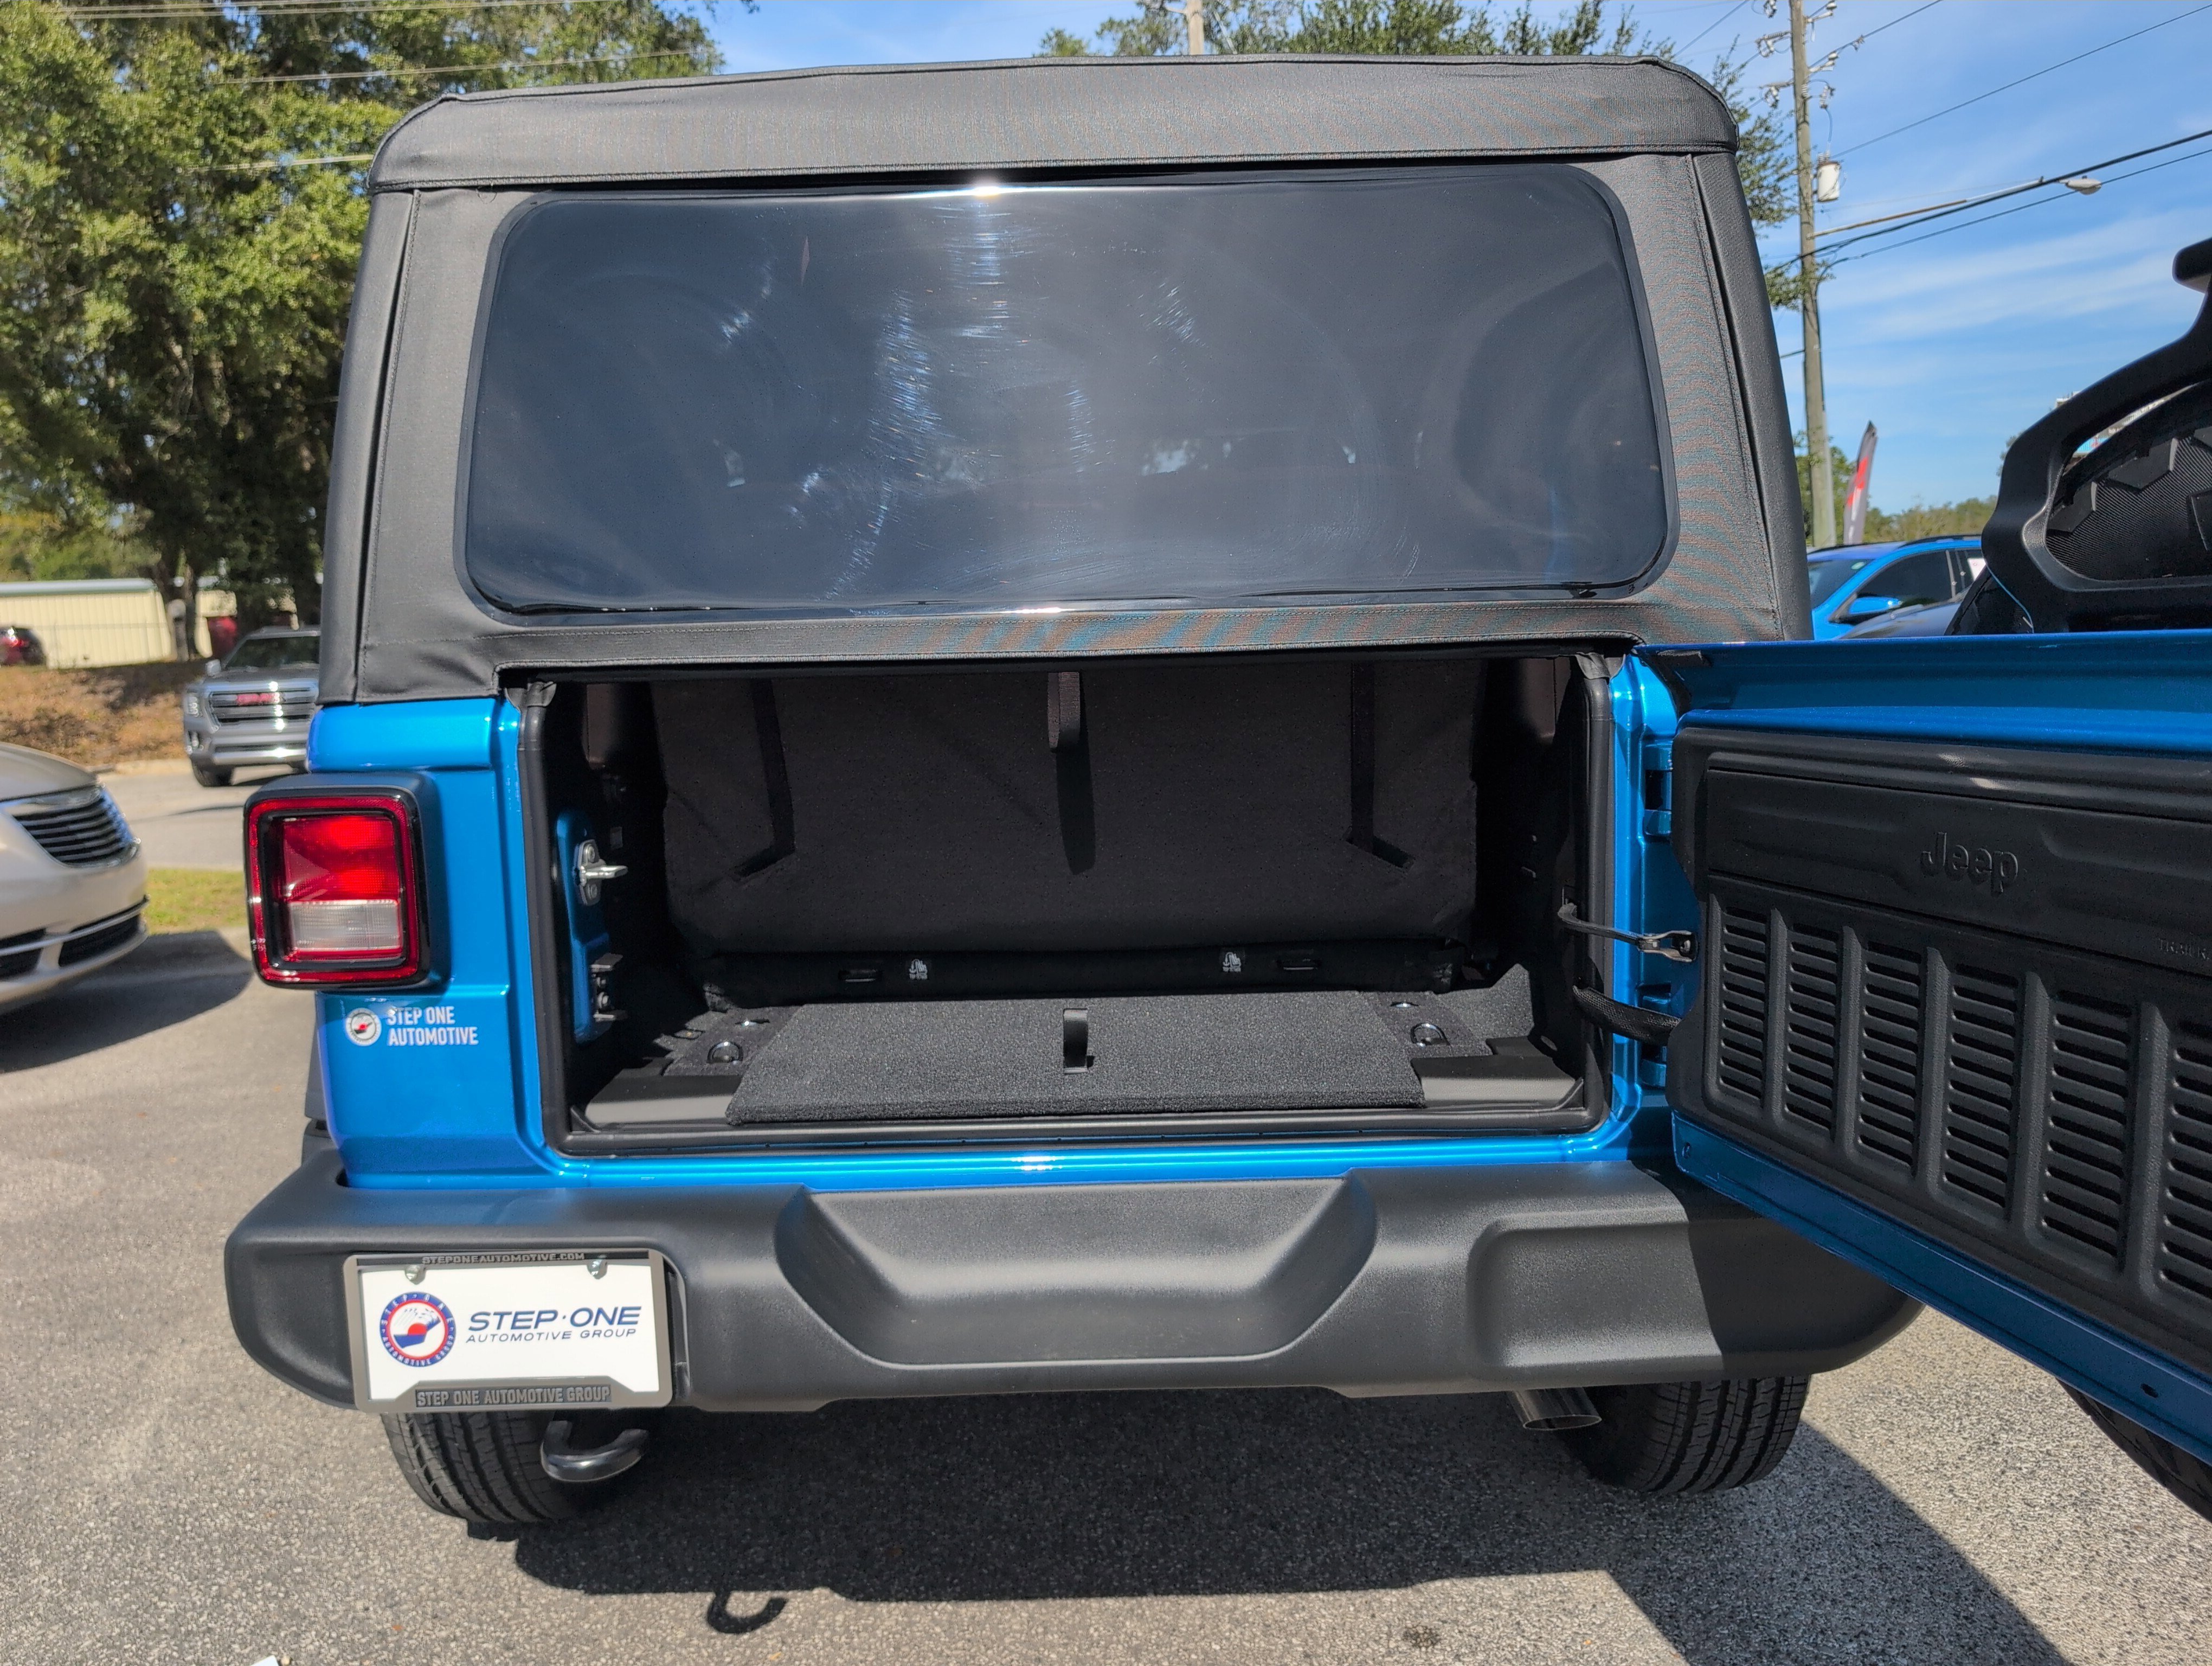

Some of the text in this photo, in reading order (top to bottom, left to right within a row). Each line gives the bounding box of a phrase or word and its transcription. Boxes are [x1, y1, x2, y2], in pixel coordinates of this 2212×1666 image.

[1920, 831, 2018, 895] Jeep
[387, 1006, 455, 1025] STEP ONE
[388, 1027, 479, 1046] AUTOMOTIVE
[422, 1253, 585, 1265] STEPONEAUTOMOTIVE.COM
[466, 1328, 636, 1343] AUTOMOTIVE GROUP
[417, 1386, 611, 1407] STEP ONE AUTOMOTIVE GROUP
